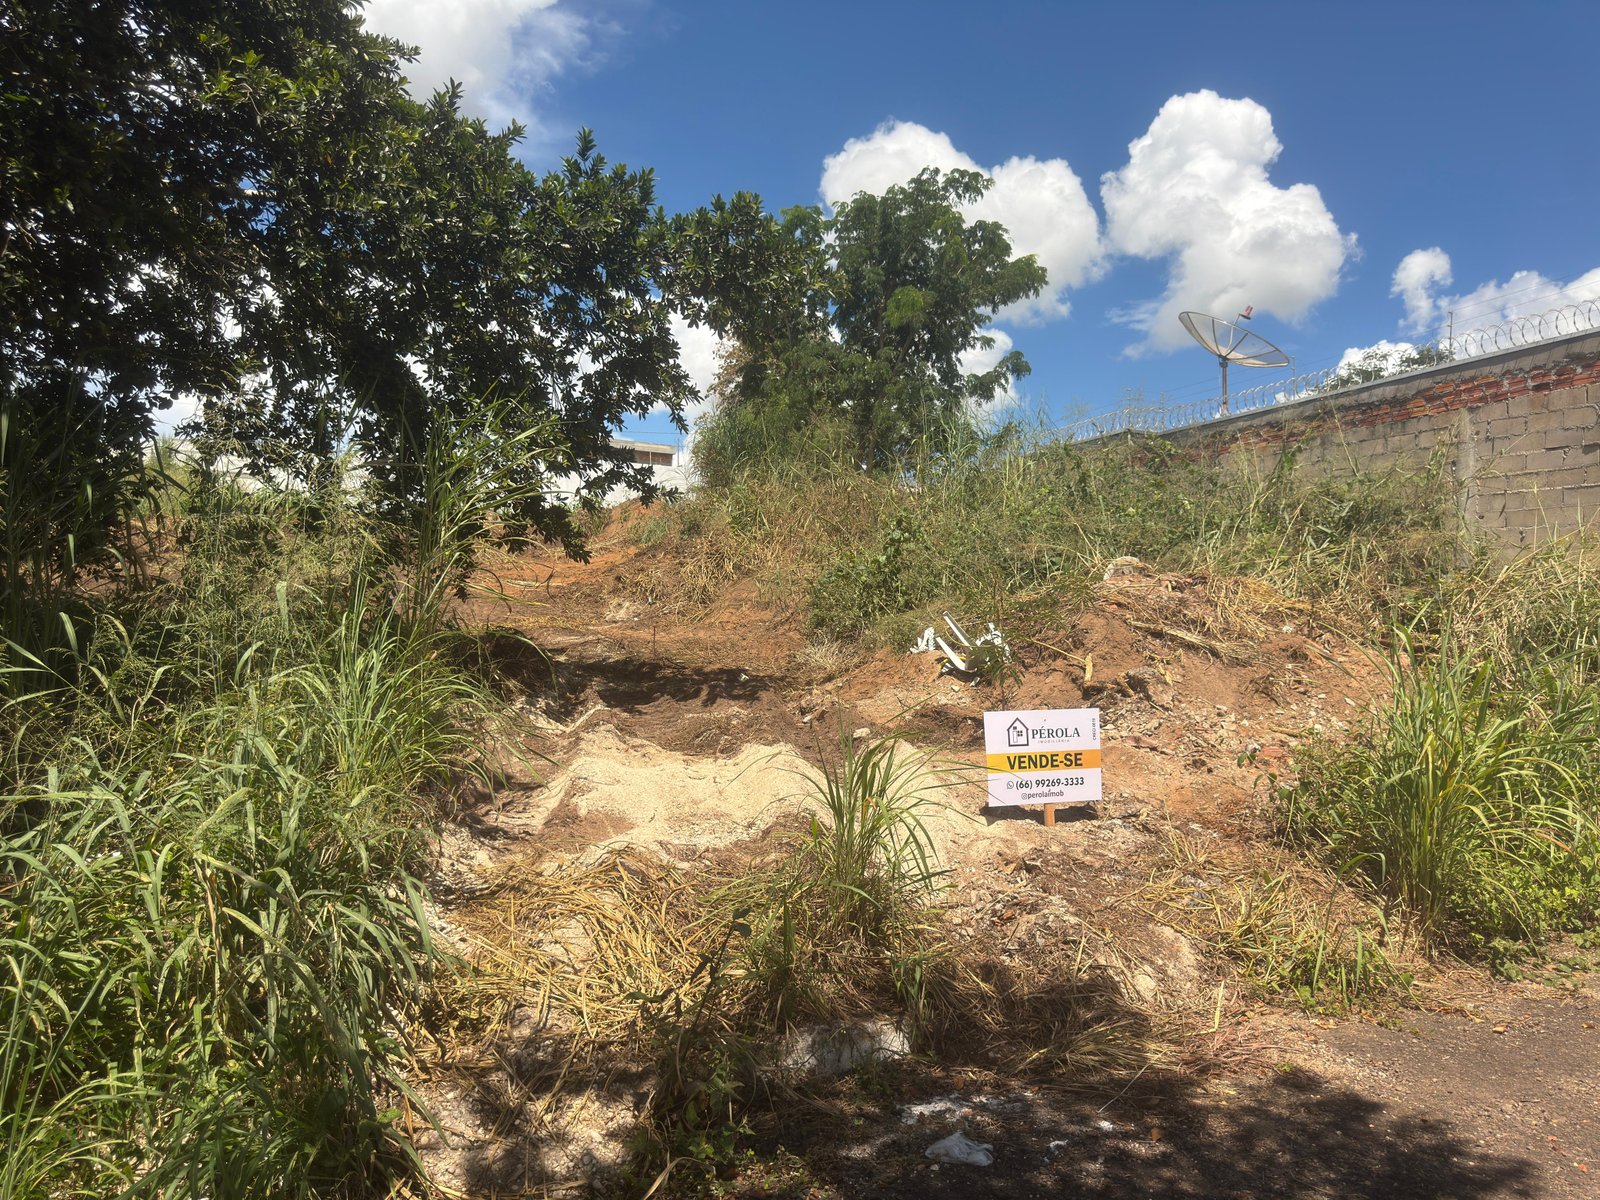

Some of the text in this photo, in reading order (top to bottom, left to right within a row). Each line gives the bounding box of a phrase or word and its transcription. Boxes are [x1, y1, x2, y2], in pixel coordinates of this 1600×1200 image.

[1031, 726, 1080, 739] PÉROLA
[1007, 753, 1083, 770] VENDE-SE
[1015, 777, 1085, 790] (66) 99269-3333
